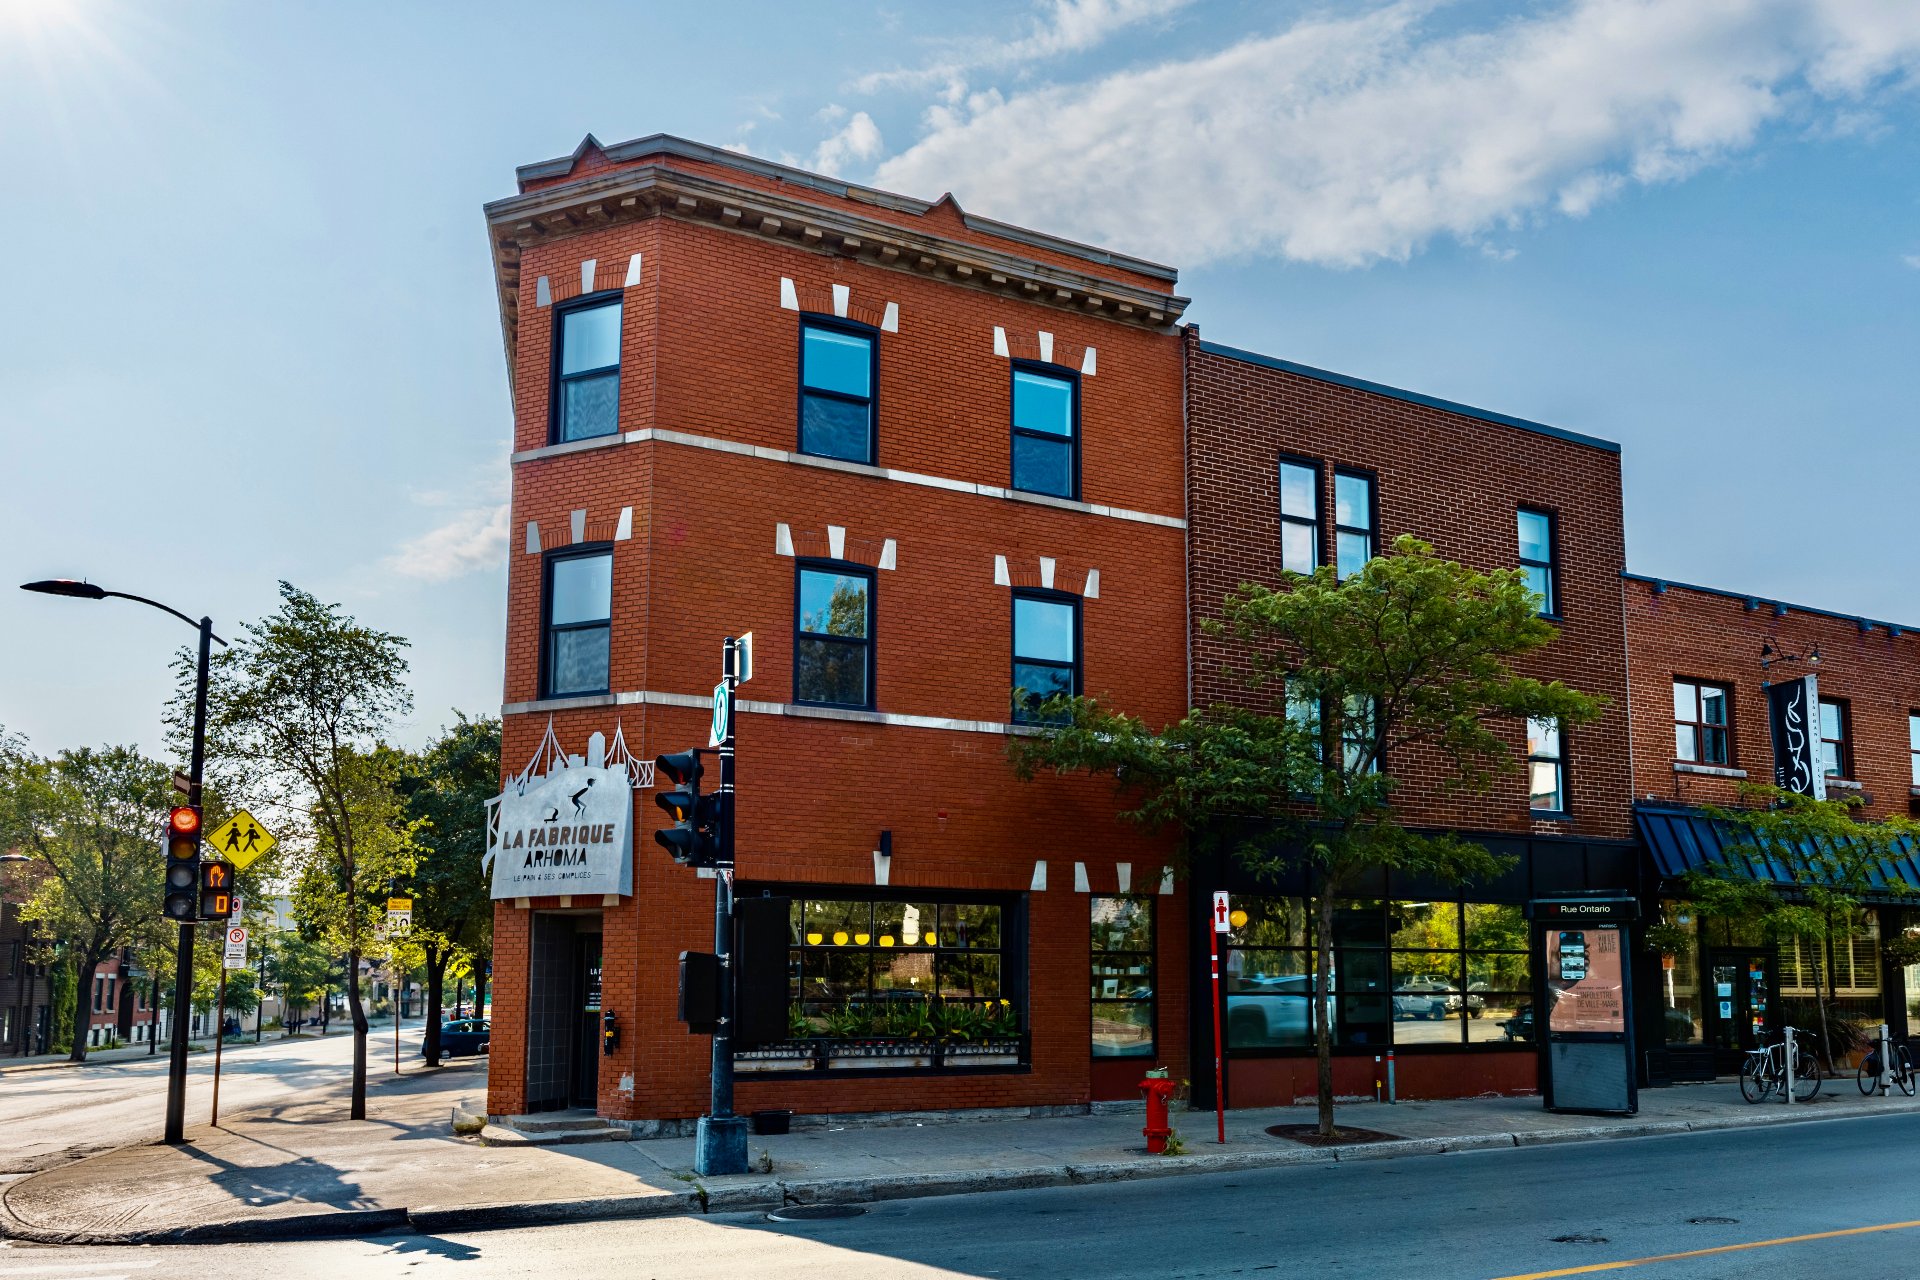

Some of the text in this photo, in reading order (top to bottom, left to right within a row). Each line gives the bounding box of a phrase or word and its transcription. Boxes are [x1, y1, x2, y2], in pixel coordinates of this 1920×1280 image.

[1785, 684, 1811, 794] extra
[503, 823, 615, 850] LA FABRIQUE
[523, 847, 587, 869] ARHOMA
[513, 874, 521, 882] LE
[523, 874, 536, 882] PAIN
[544, 873, 556, 881] SES
[557, 871, 592, 880] COMPLICES
[1560, 905, 1611, 913] Rue Ontario
[1576, 1000, 1585, 1008] DE
